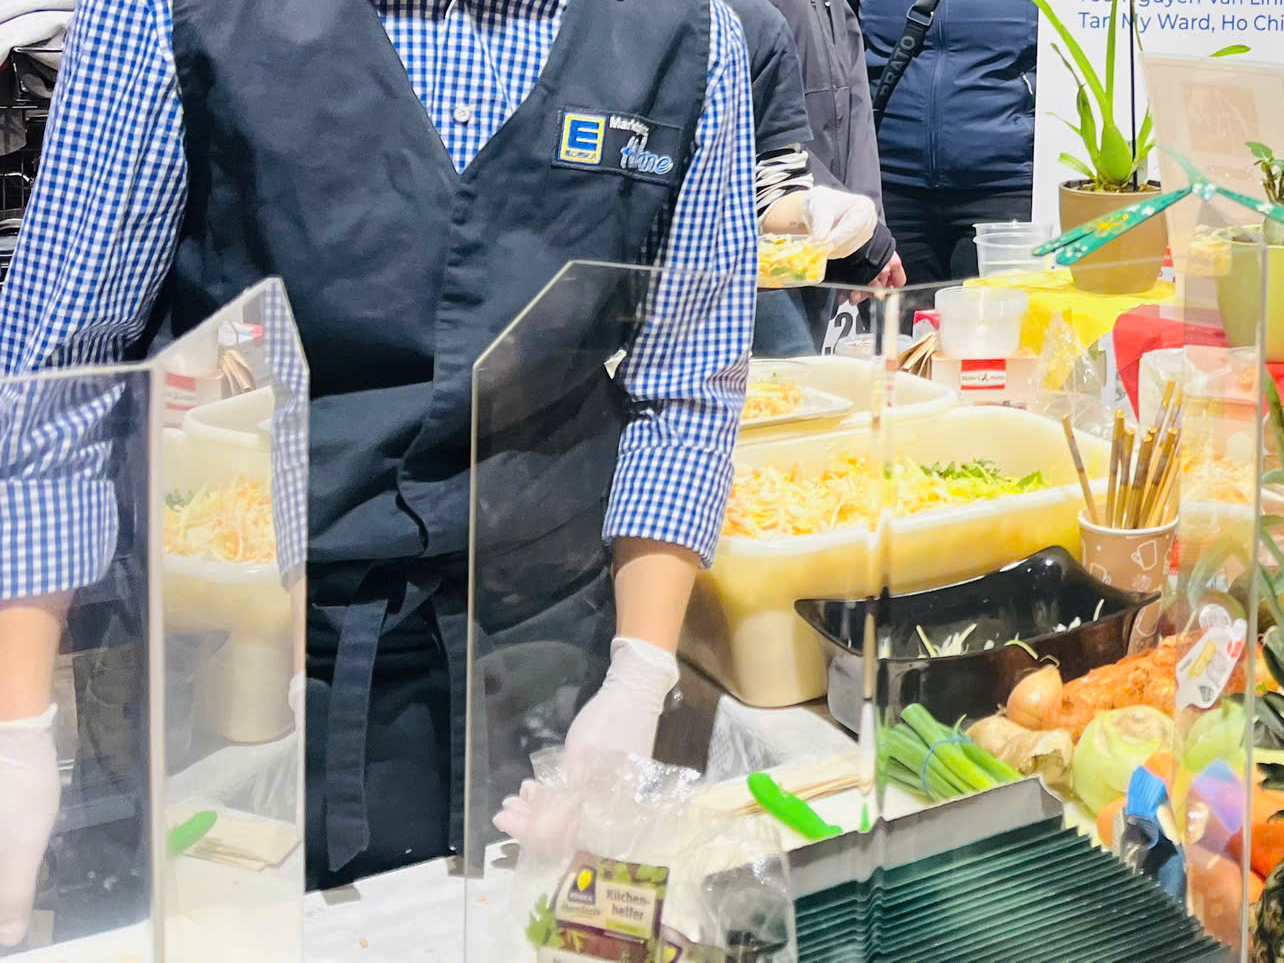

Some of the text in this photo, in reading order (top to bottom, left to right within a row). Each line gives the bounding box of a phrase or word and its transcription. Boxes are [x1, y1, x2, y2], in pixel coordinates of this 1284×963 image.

[1157, 13, 1216, 34] Ward,
[1222, 14, 1248, 31] Ho
[1253, 13, 1284, 31] Chi
